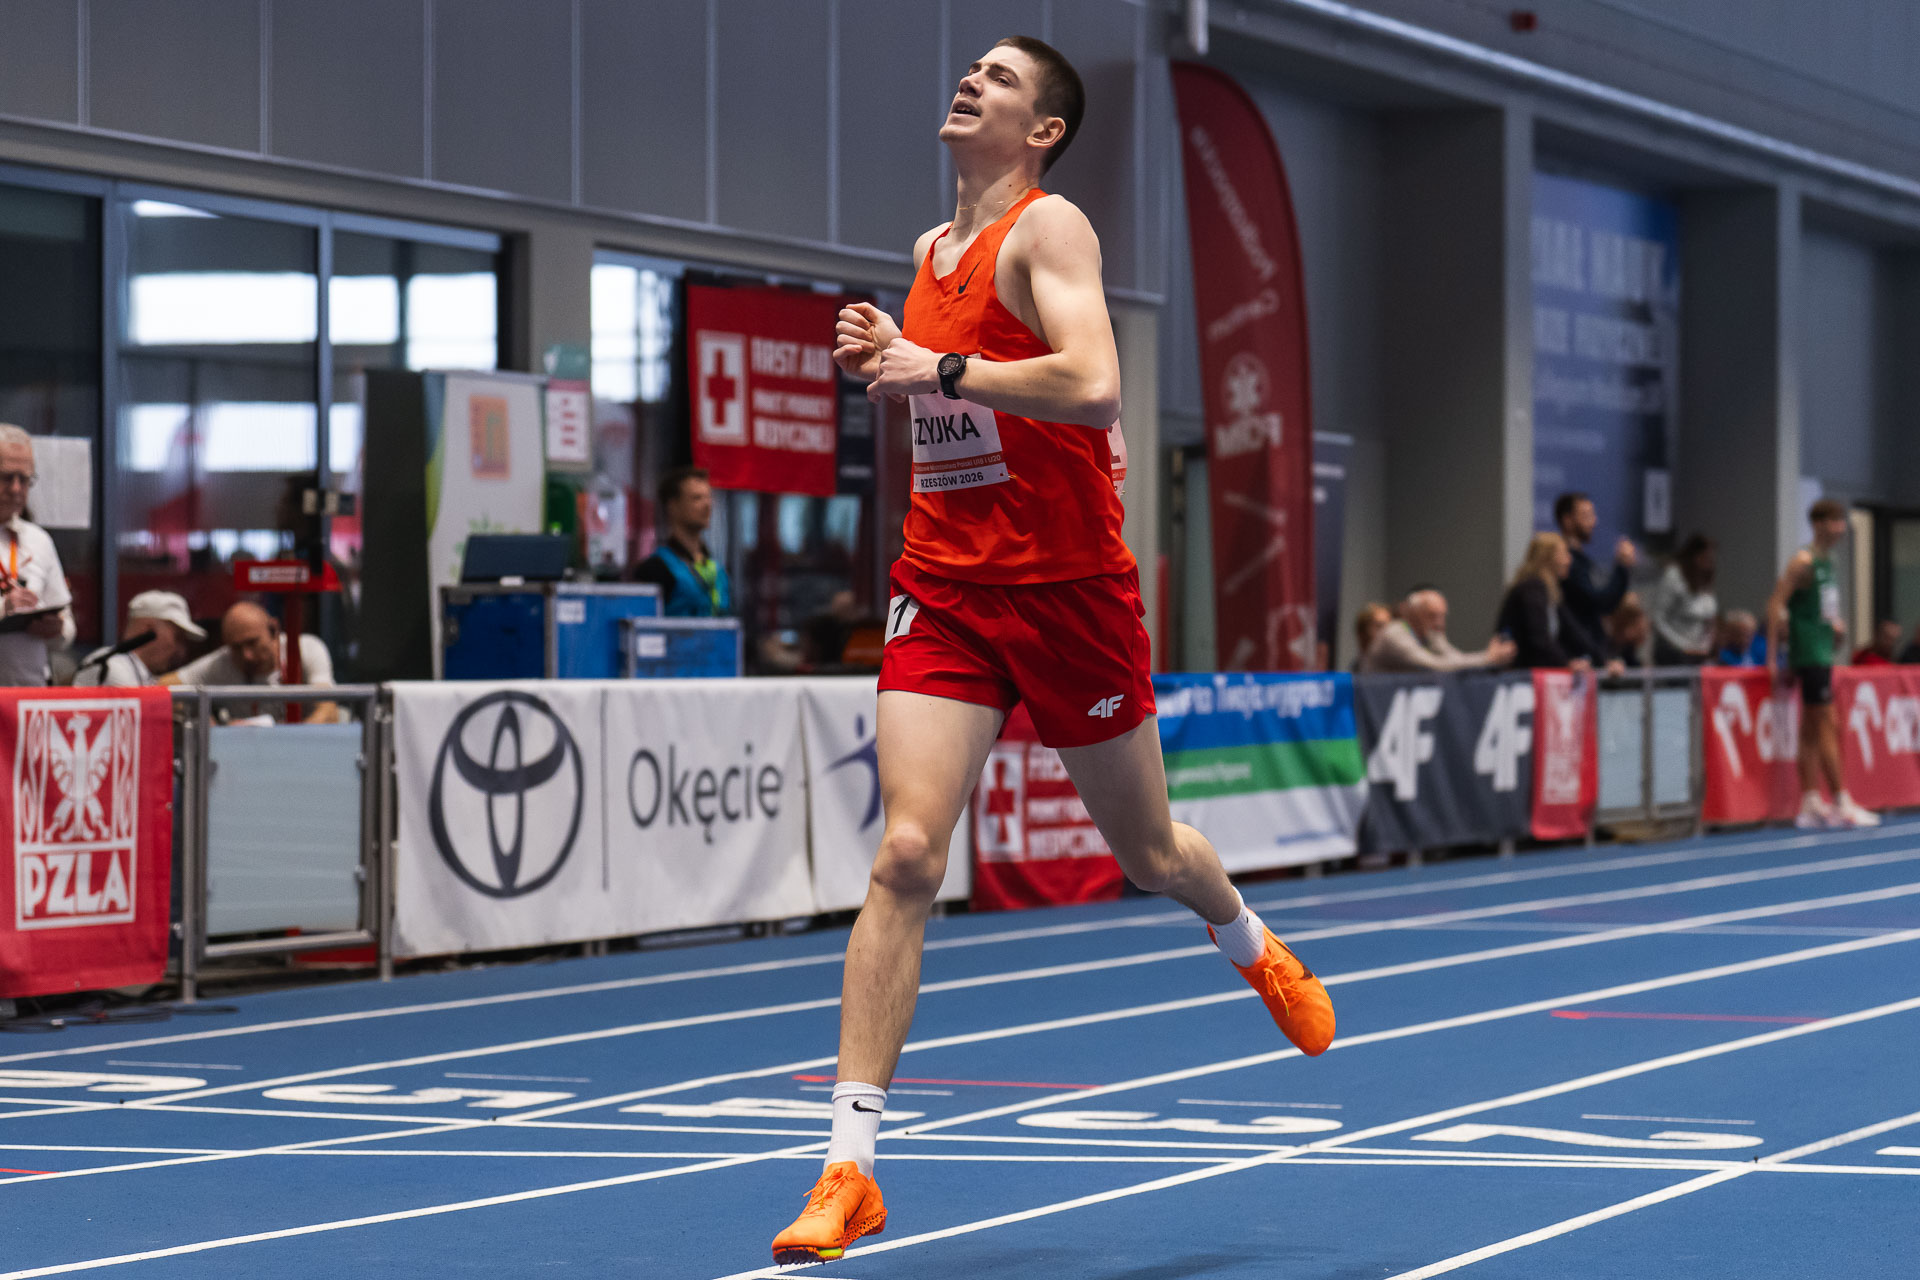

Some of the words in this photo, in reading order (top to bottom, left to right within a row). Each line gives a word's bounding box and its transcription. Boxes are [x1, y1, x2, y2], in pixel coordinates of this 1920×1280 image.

[914, 412, 981, 445] ZYJKA
[988, 454, 1002, 463] U20
[921, 474, 957, 488] RZESZÓW
[960, 472, 984, 484] 2026
[894, 596, 911, 635] 1
[1088, 694, 1124, 718] 4F
[1368, 687, 1443, 800] 4F
[1474, 683, 1536, 791] 4F
[628, 743, 783, 845] Okęcie
[23, 850, 130, 917] PZLA
[1410, 1123, 1764, 1150] 2
